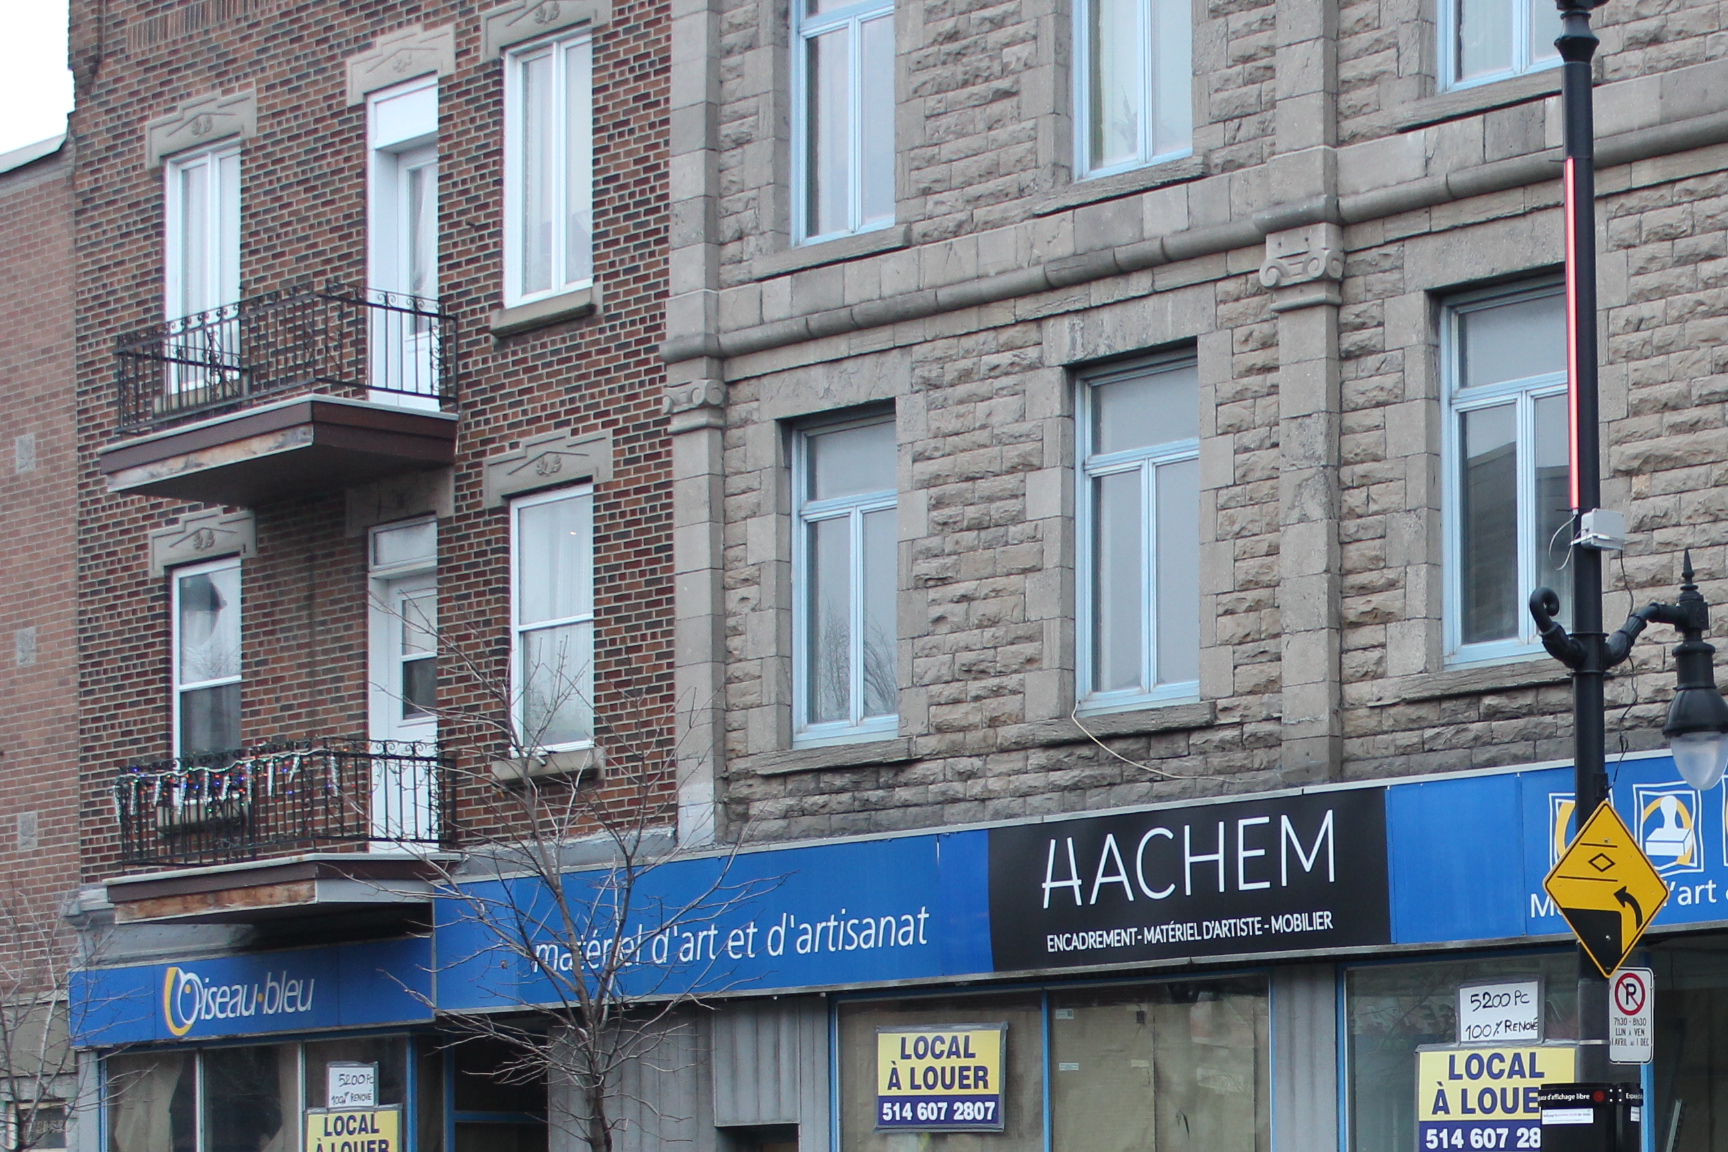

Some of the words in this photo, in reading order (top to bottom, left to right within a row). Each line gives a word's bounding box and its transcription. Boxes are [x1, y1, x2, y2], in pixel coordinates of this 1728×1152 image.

[1041, 809, 1335, 909] HACHEM
[652, 922, 718, 964] d'art
[727, 921, 759, 959] et
[767, 905, 930, 957] d'artisanat
[1047, 927, 1138, 953] ENCADREMENT
[1144, 920, 1202, 945] MATÉRIEL
[1271, 911, 1334, 934] MOBILIER
[1470, 991, 1511, 1012] 5200
[1514, 989, 1530, 1006] PC
[1614, 1017, 1628, 1026] 7h30
[1632, 1017, 1647, 1027] 8h30
[1615, 1027, 1626, 1036] LUN
[1634, 1028, 1645, 1036] VEN
[900, 1035, 976, 1060] LOCAL
[1615, 1038, 1628, 1046] AVRIL
[887, 1060, 902, 1090] À
[910, 1066, 989, 1090] LOUER
[1448, 1052, 1545, 1081] LOCAL
[339, 1073, 365, 1087] 5200
[1431, 1081, 1450, 1115] À
[1461, 1087, 1541, 1114] LOUE
[882, 1102, 912, 1120] 514
[917, 1102, 948, 1120] 607
[953, 1101, 996, 1120] 2807
[324, 1114, 380, 1137] LOCAL
[1425, 1128, 1464, 1149] 514
[1470, 1127, 1509, 1149] 607
[1516, 1127, 1541, 1149] 28
